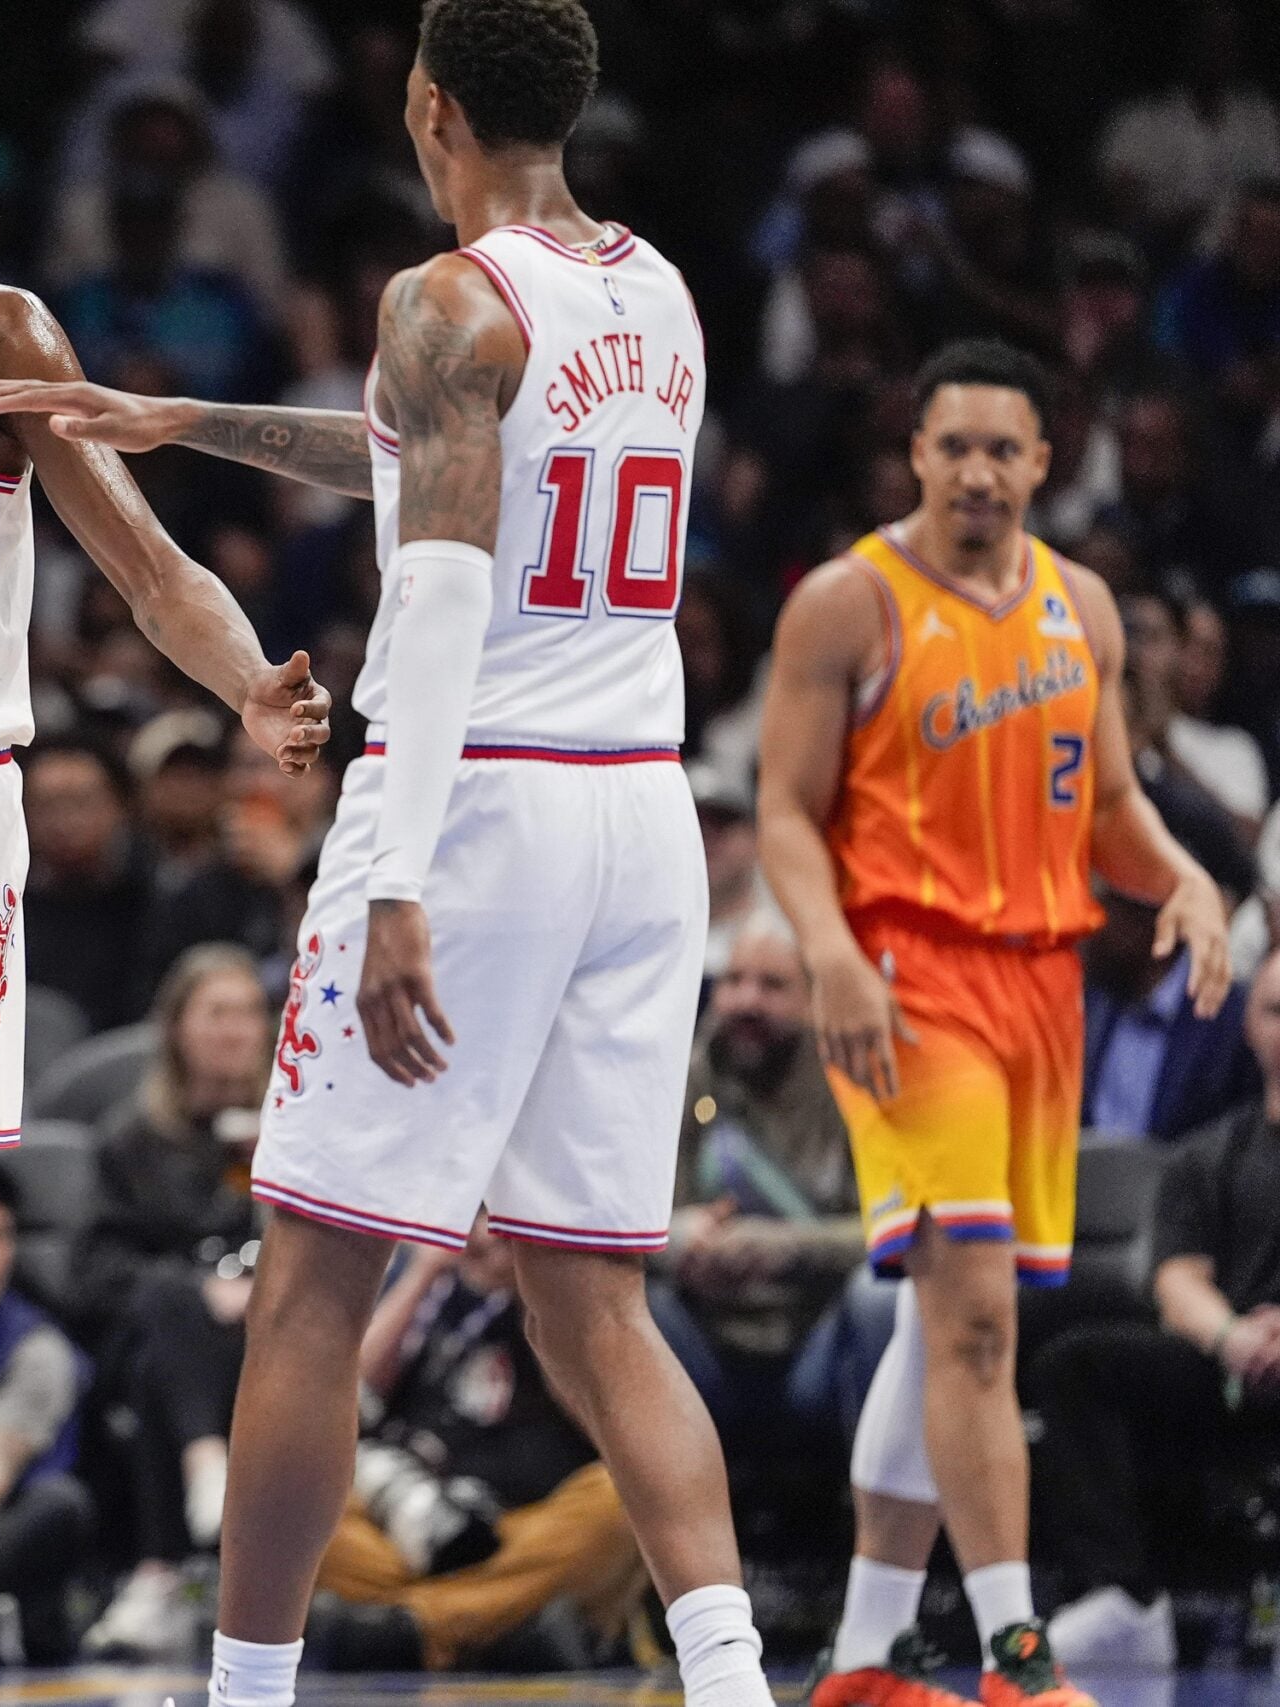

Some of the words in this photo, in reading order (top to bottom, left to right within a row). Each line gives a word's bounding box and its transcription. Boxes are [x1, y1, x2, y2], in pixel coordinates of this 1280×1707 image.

[545, 333, 644, 432] SMITH
[656, 353, 694, 432] JR
[520, 447, 687, 619] 10
[1050, 734, 1084, 803] 2
